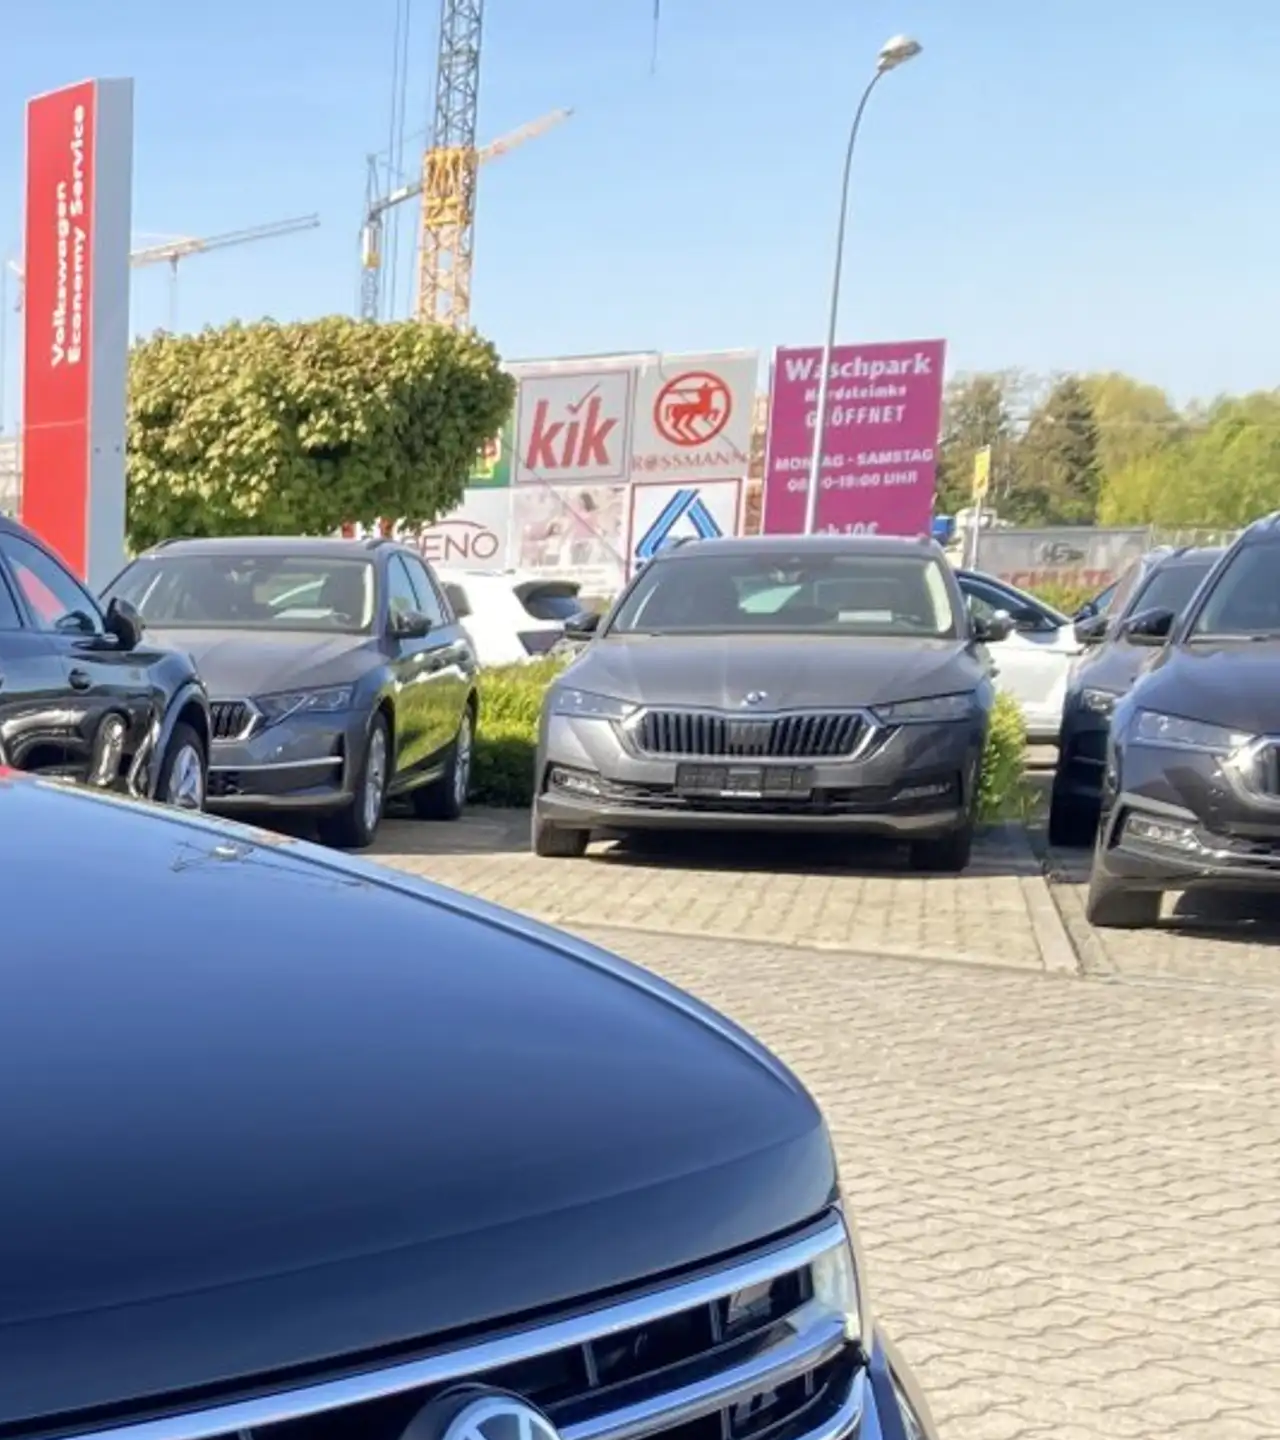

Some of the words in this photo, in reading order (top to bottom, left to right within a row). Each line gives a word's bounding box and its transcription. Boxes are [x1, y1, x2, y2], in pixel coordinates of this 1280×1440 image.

[69, 105, 85, 216] Service
[51, 181, 69, 367] Volkswagen
[67, 226, 85, 363] Economy
[785, 352, 932, 381] Waschpark
[805, 384, 907, 401] Nrdsteimke
[805, 405, 906, 428] GÖFFNET
[633, 451, 748, 473] ROSSMANN
[775, 453, 845, 472] MONAG
[857, 448, 933, 467] SAMSTAG
[884, 471, 918, 485] UHR
